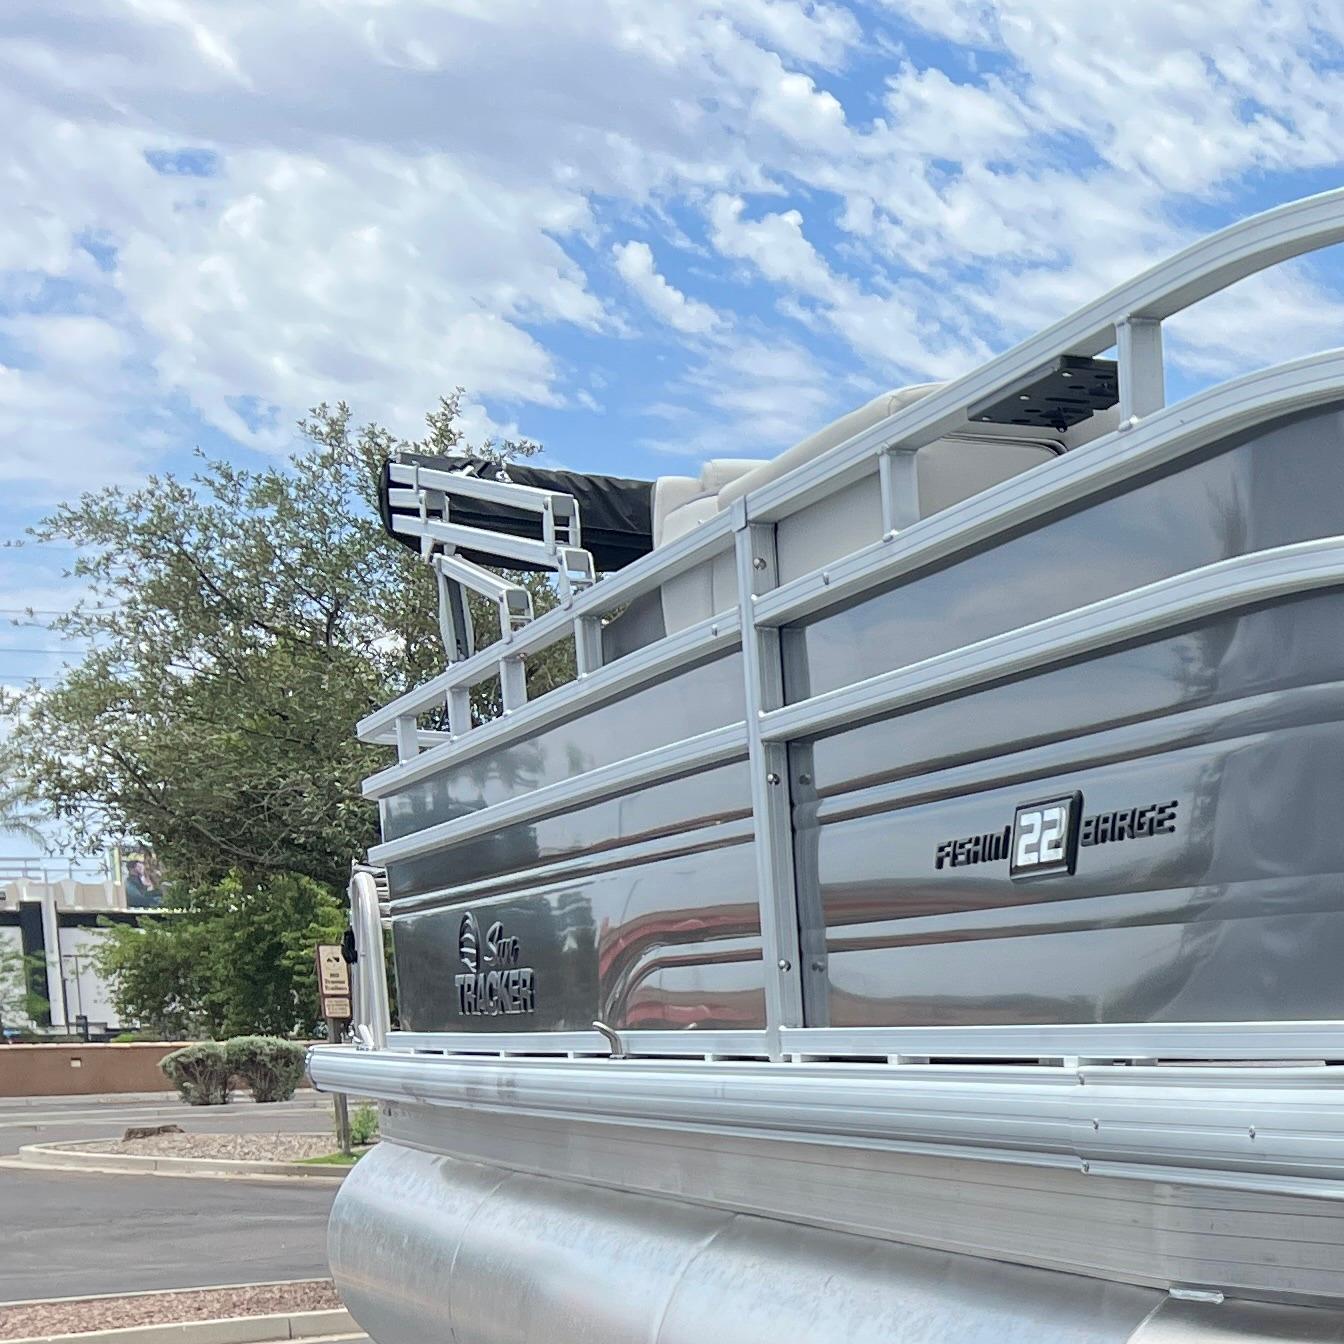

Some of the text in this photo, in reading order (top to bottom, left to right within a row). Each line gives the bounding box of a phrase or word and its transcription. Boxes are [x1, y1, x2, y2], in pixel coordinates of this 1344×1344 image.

[1017, 807, 1067, 867] 22
[1081, 800, 1178, 847] BARGE
[483, 921, 520, 966] Sun
[455, 967, 534, 1016] TRACKER
